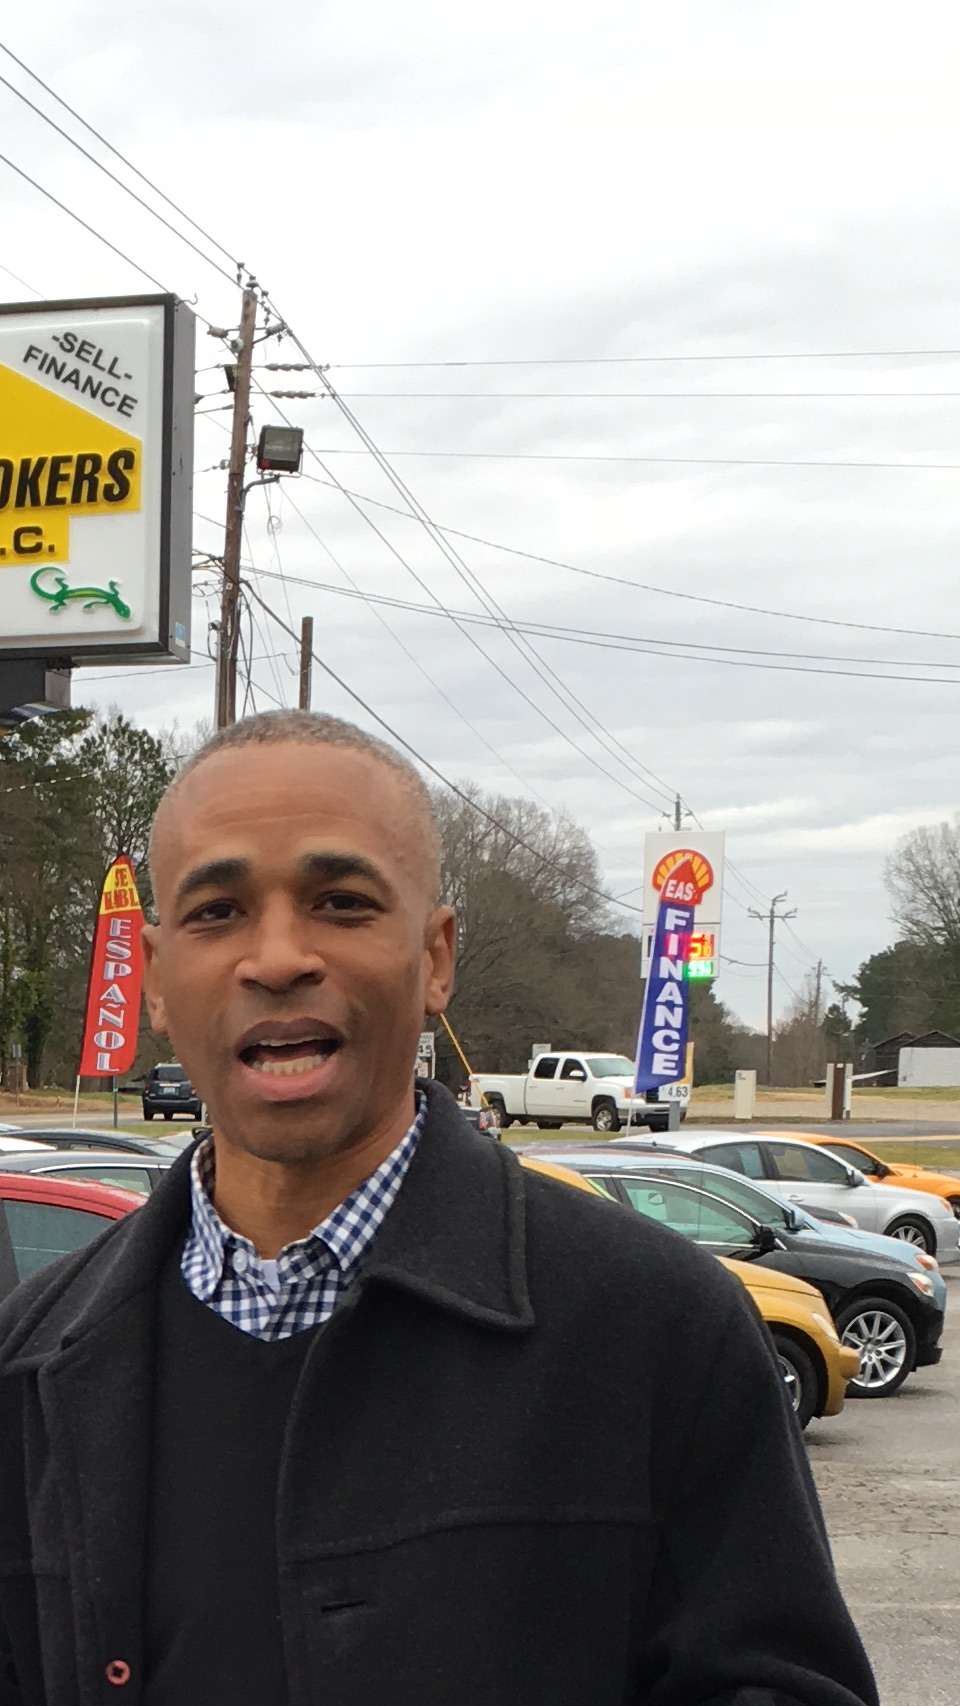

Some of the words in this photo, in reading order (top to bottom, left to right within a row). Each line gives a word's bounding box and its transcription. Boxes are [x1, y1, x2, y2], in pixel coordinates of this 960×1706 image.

[22, 344, 139, 418] FINANCE
[115, 868, 128, 887] SE
[665, 879, 695, 901] EAS
[93, 917, 132, 1072] ESPAÑOL
[651, 907, 690, 1077] FINANCE
